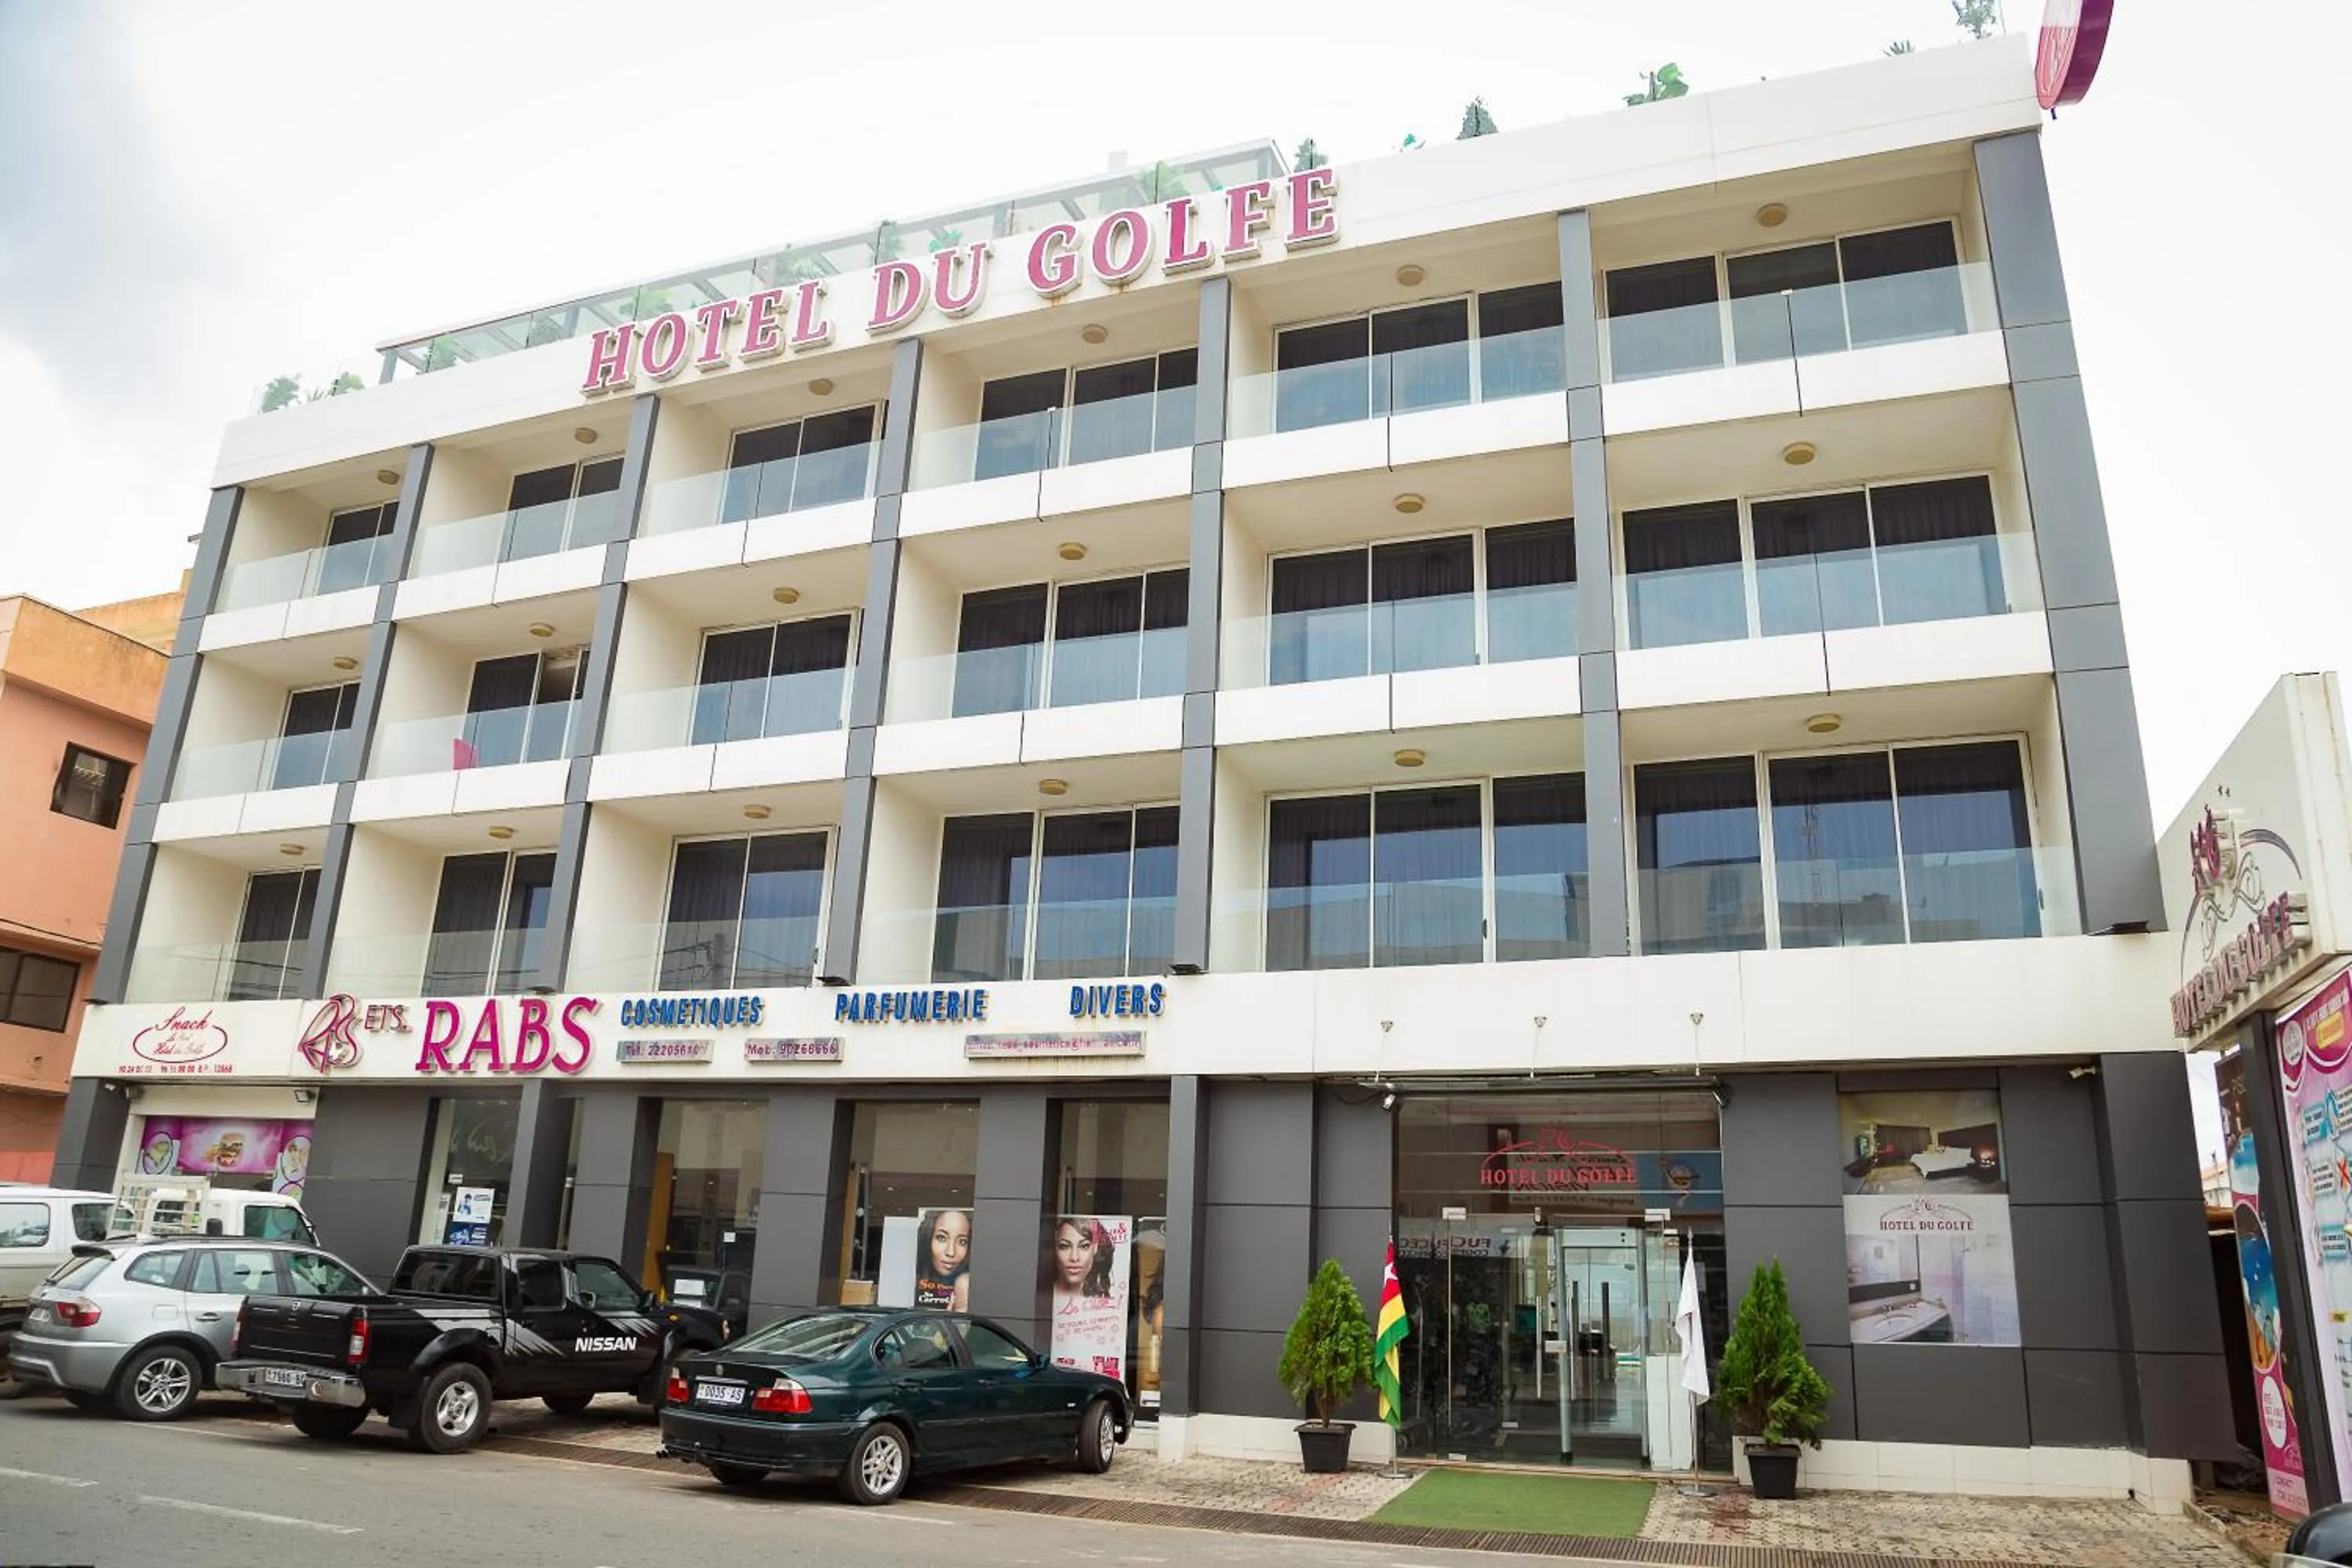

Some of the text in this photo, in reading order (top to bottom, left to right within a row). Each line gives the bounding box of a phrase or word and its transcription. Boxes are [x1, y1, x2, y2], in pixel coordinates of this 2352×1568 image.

[581, 167, 1338, 394] HOTEL DU GOLFE
[155, 1007, 212, 1031] Snack
[620, 983, 1167, 1029] COSMETIQUES PARFUMERIE DIVERS
[415, 996, 601, 1075] RABS
[1480, 1169, 1538, 1185] HOTEL
[1548, 1168, 1570, 1184] DU
[575, 1337, 637, 1352] NISSAN
